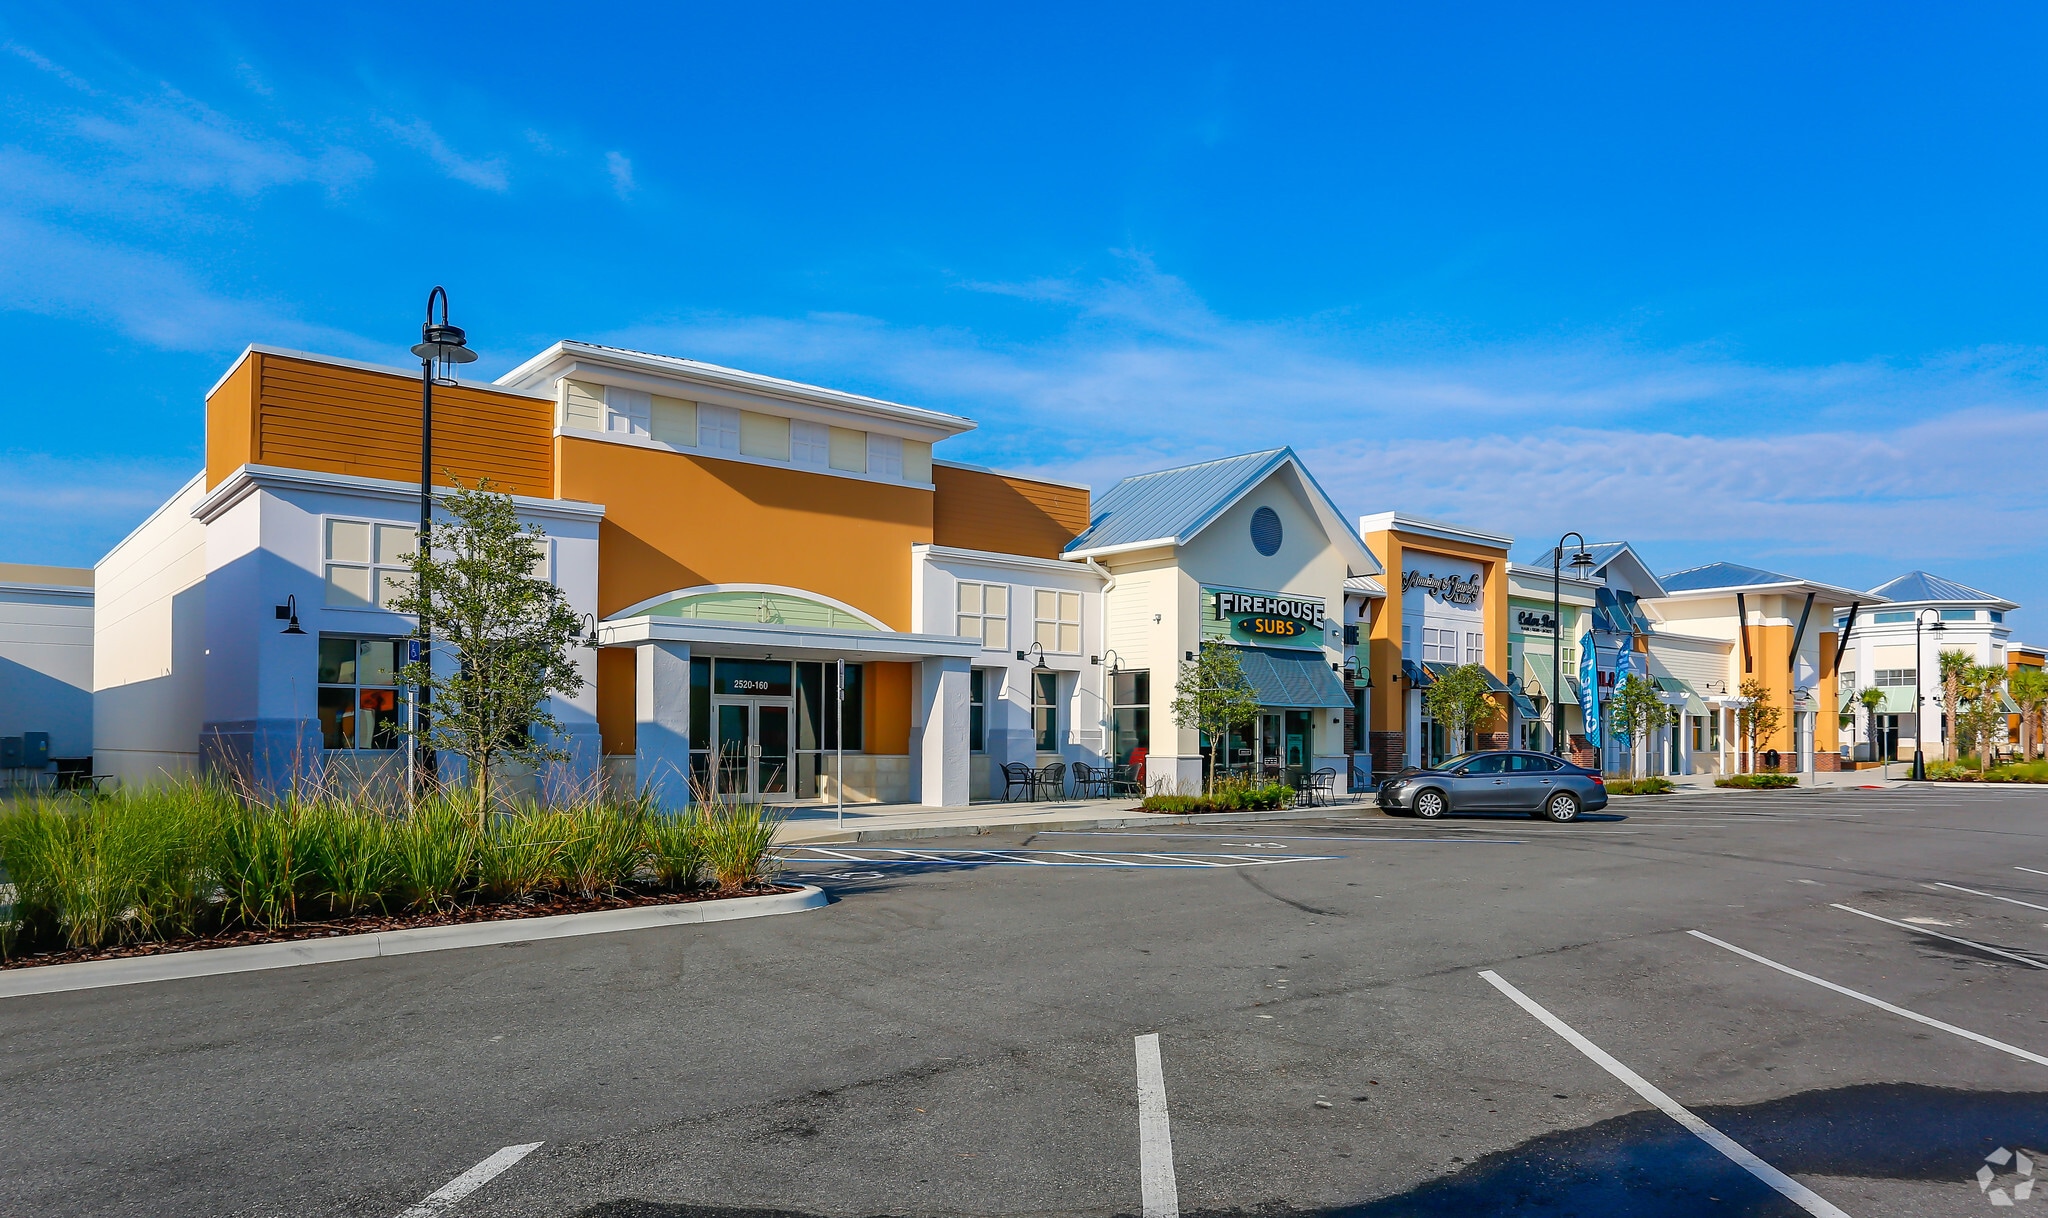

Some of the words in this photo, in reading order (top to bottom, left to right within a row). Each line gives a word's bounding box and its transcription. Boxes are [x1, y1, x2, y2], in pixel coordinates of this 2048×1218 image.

[1216, 593, 1324, 630] FIREHOUSE
[1255, 618, 1294, 635] SUBS
[734, 679, 769, 690] 2520-160
